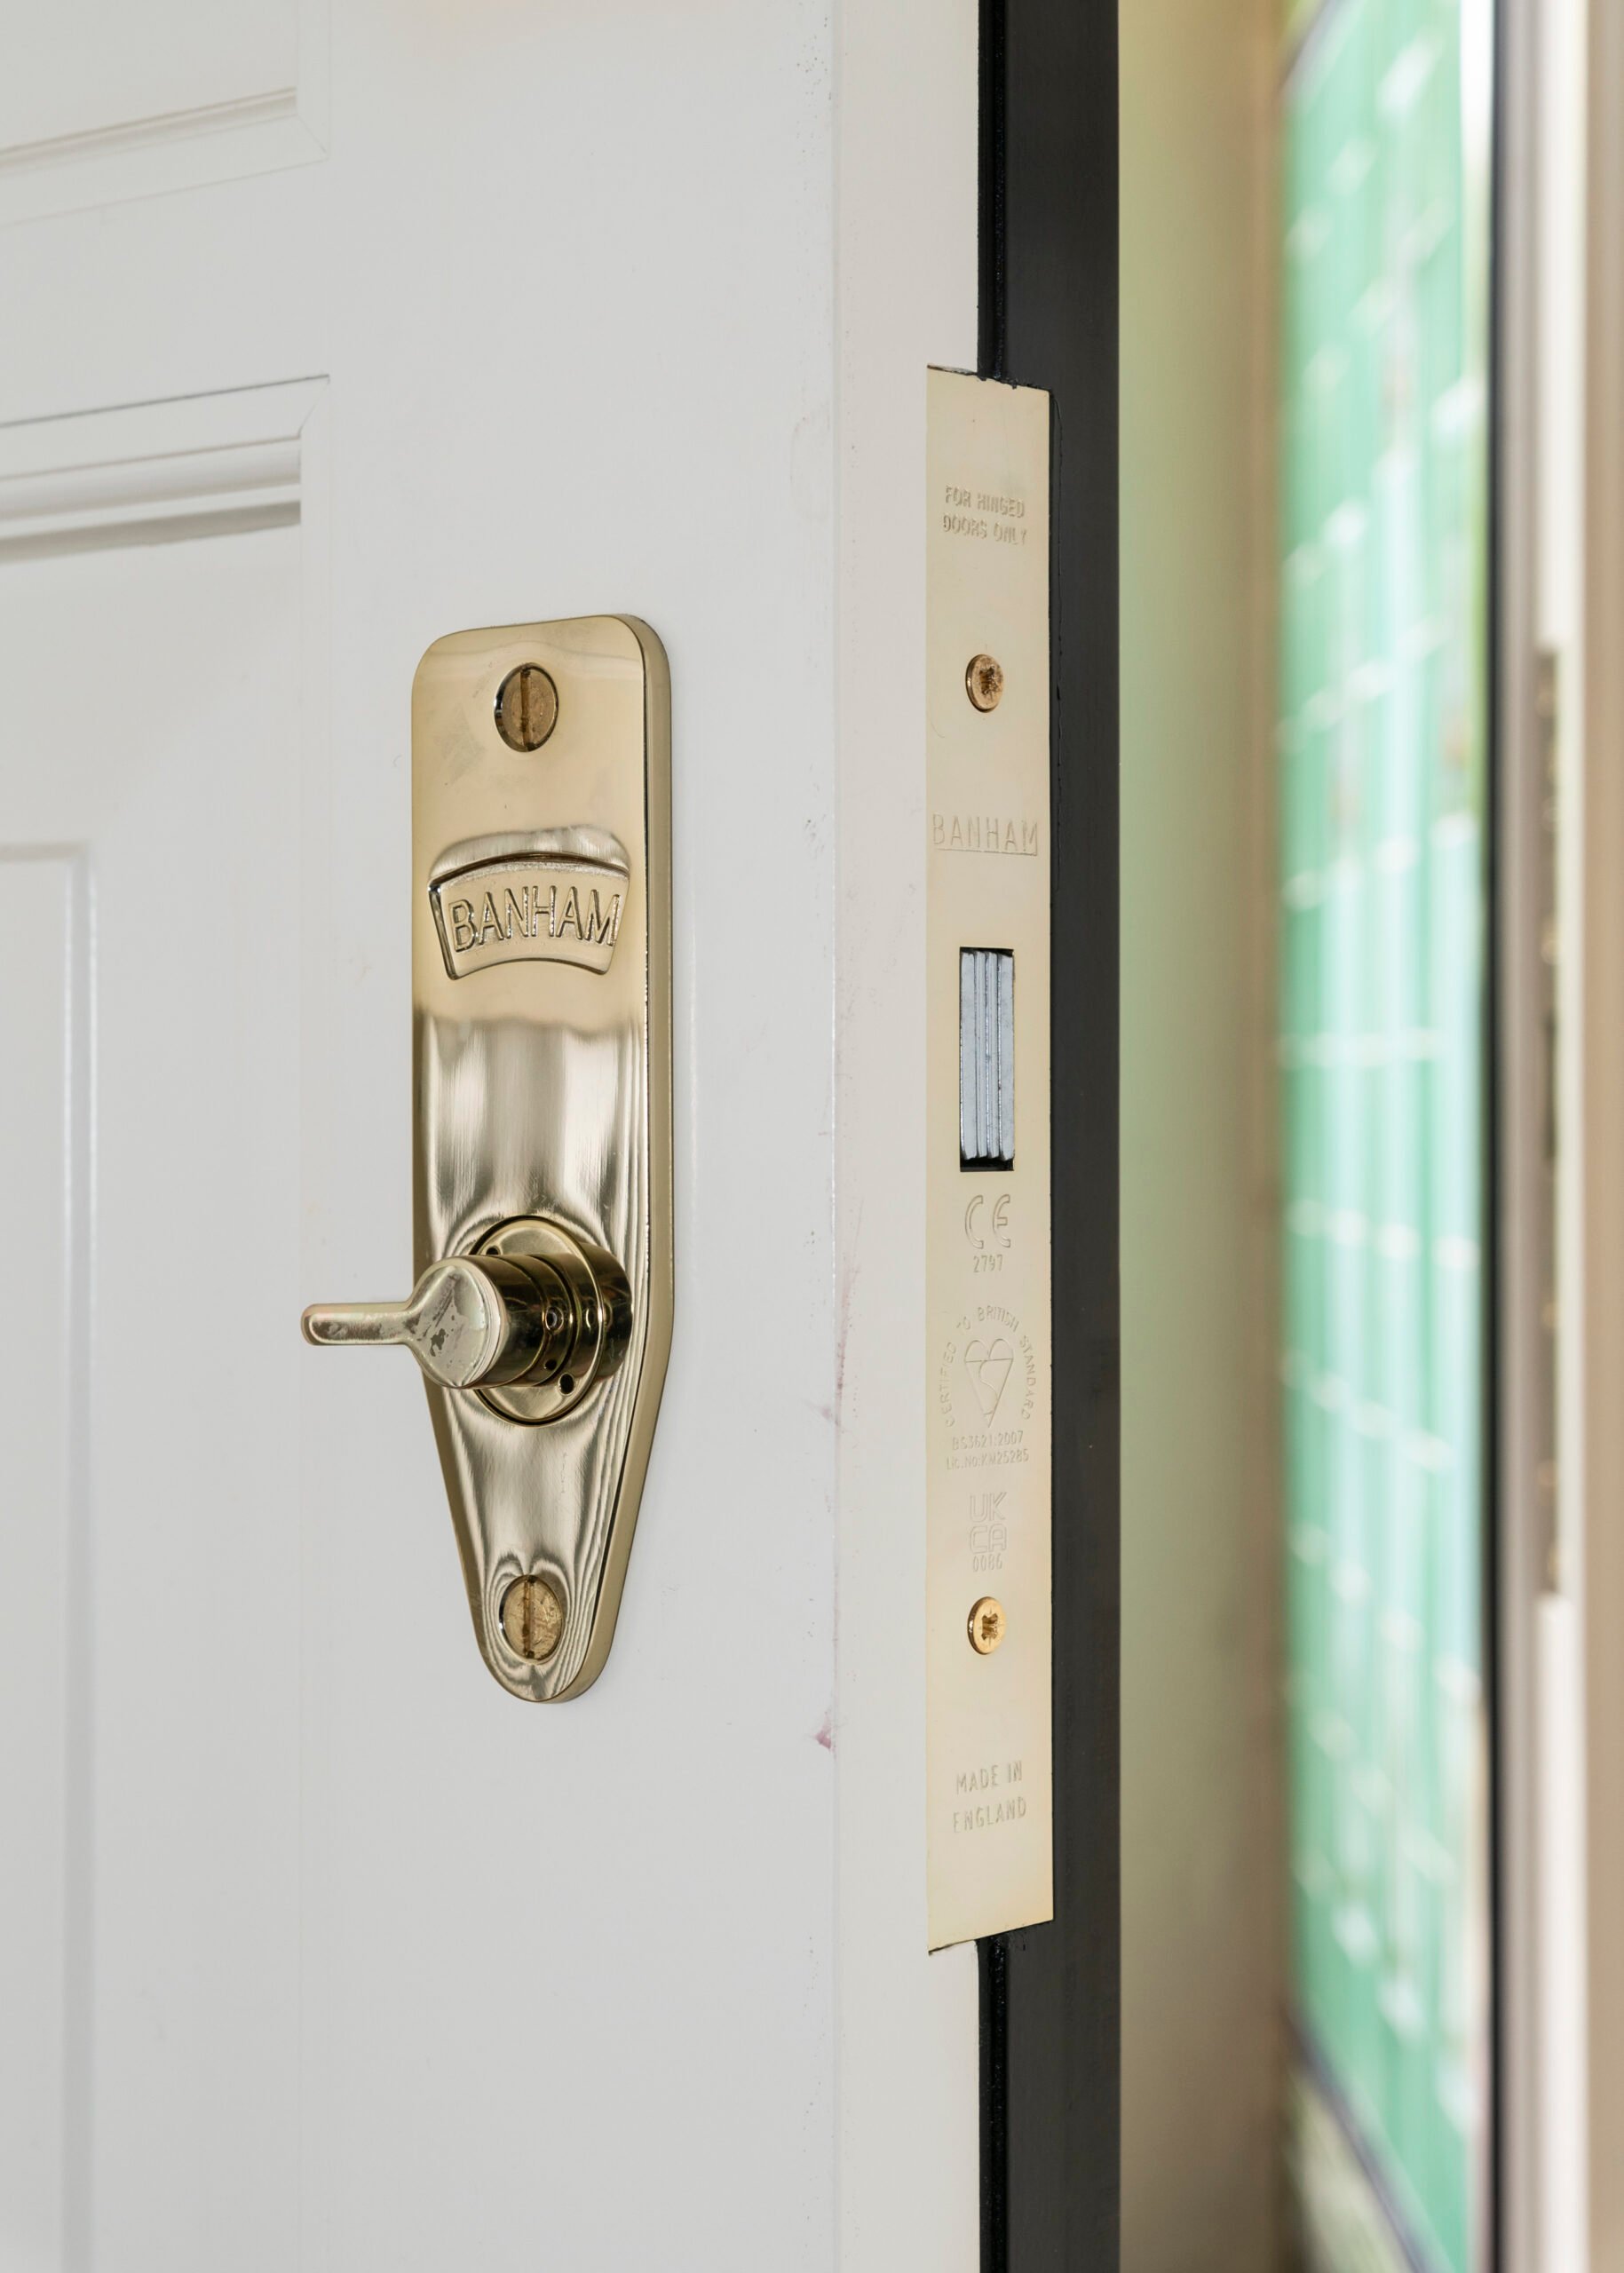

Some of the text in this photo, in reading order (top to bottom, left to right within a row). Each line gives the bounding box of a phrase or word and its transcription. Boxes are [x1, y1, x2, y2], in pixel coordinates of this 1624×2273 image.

[945, 484, 1026, 519] FOR HINGED
[942, 512, 1027, 545] DOORS ONLY
[932, 812, 1038, 852] BANHAM
[448, 885, 622, 952] BANHAM
[964, 1193, 1011, 1250] CE
[938, 1342, 957, 1428] CERTIFIED
[976, 1304, 1020, 1333] BRITISH
[969, 1491, 1008, 1524] UK
[969, 1522, 1008, 1554] CA
[955, 1760, 1023, 1795] MADE IN
[952, 1795, 1027, 1833] ENGLAND
